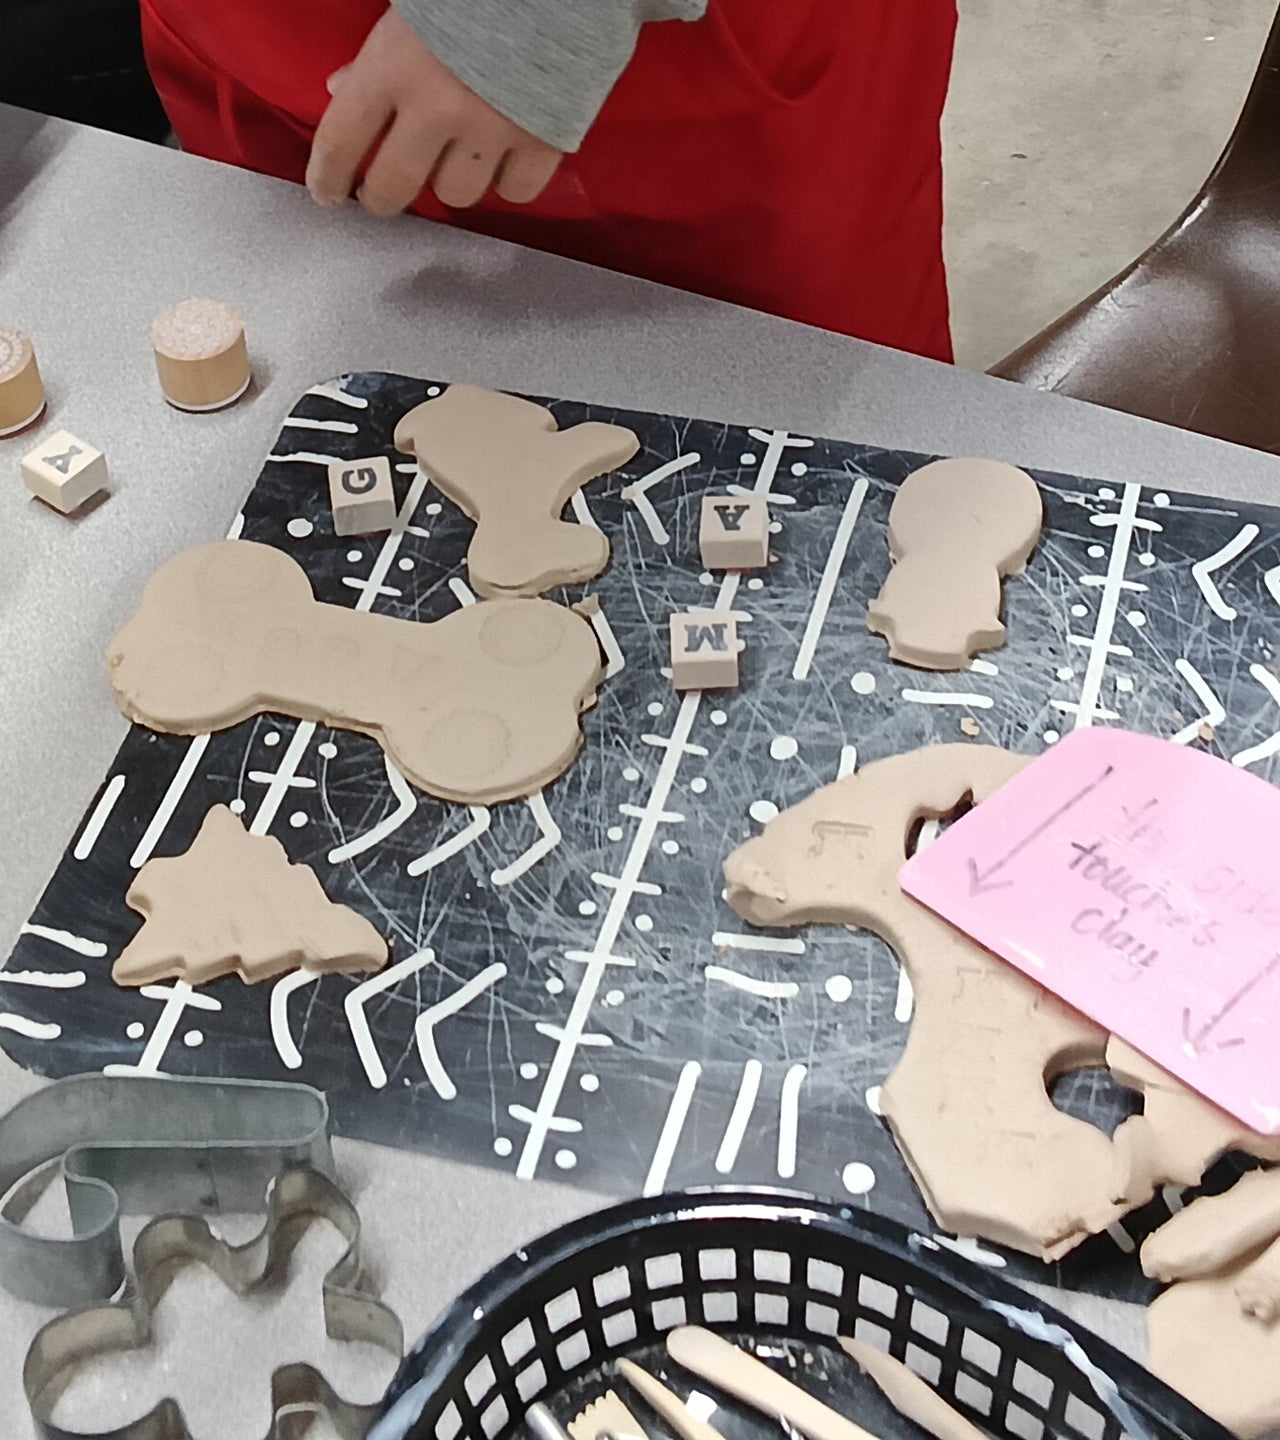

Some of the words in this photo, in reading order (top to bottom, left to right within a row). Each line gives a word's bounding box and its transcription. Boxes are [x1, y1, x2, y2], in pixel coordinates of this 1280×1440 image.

[341, 467, 377, 494] G
[713, 505, 750, 531] A
[684, 623, 728, 652] M
